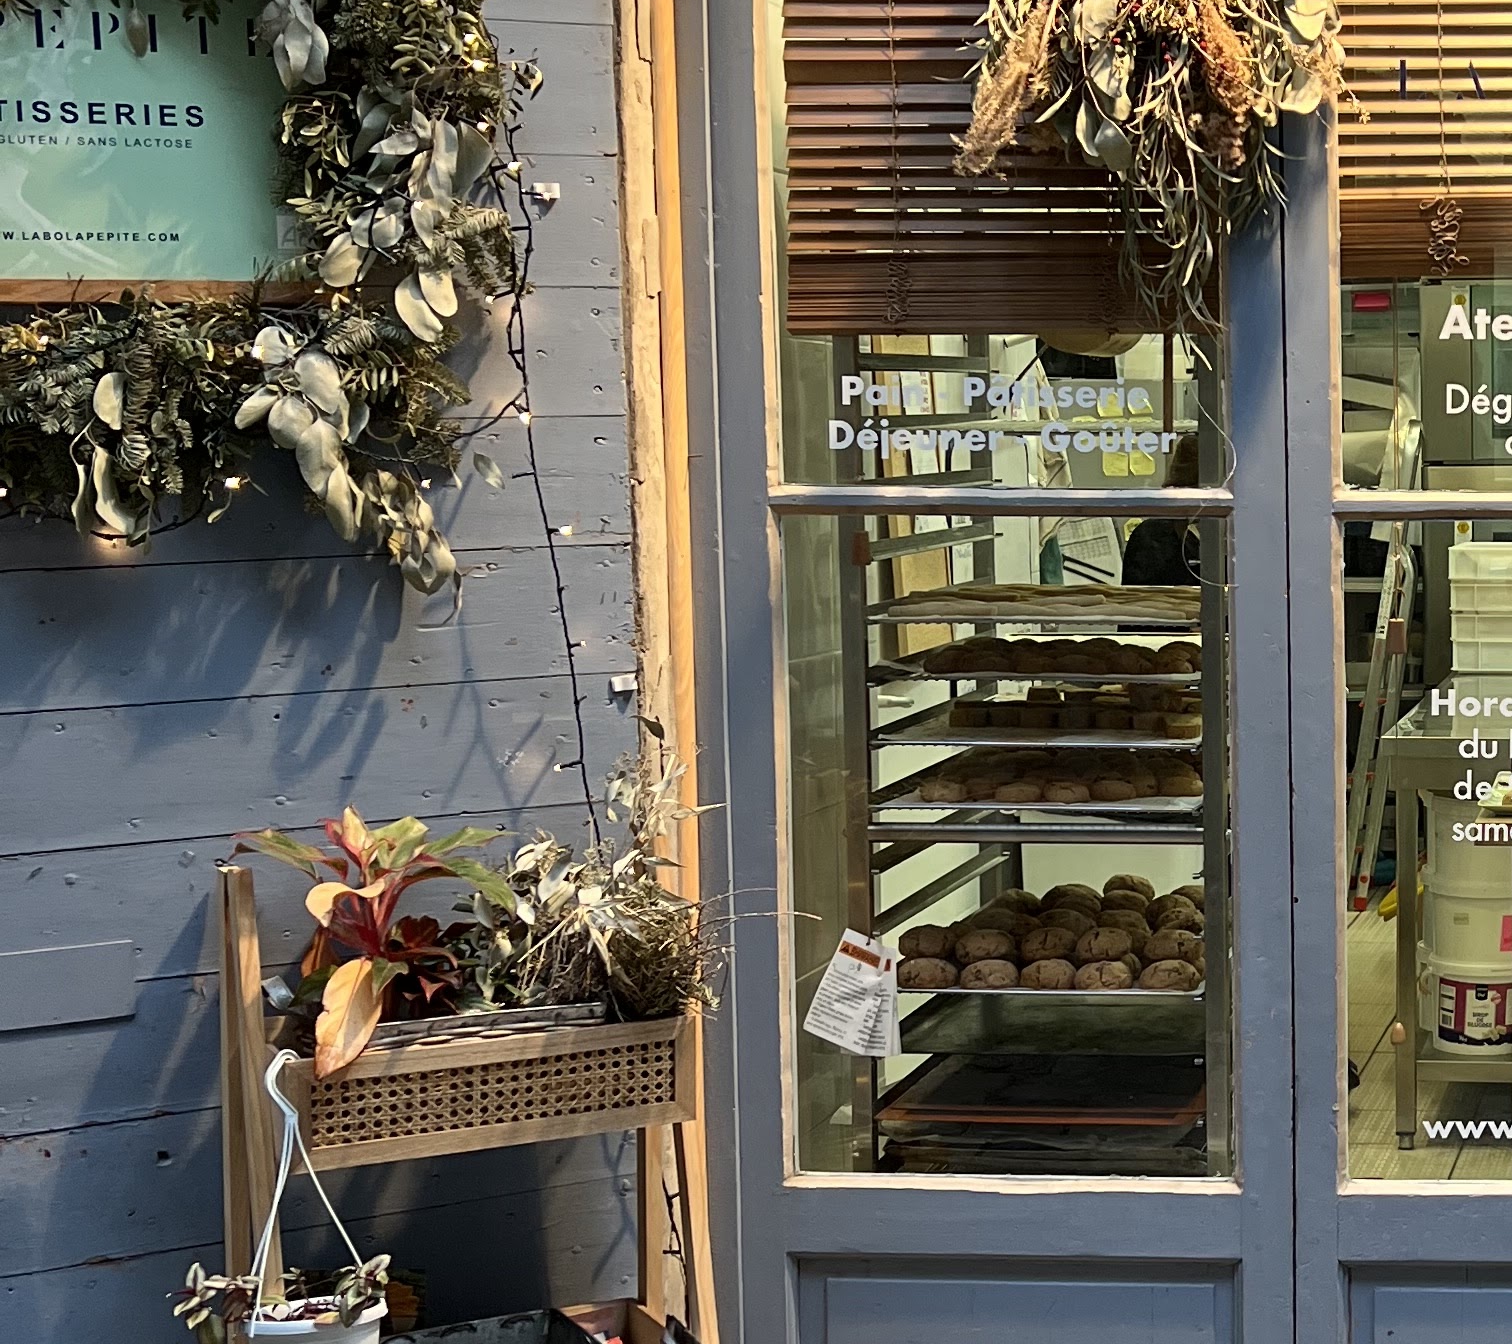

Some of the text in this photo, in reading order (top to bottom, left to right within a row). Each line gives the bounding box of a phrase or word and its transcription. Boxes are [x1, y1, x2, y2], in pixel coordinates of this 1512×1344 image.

[1400, 59, 1487, 100] LA
[77, 136, 117, 147] SANS
[125, 138, 193, 149] LACTOSE
[841, 375, 925, 407] Pain
[964, 376, 1150, 410] Pâtisserie
[828, 417, 1008, 460] Déjeuner
[1040, 422, 1178, 455] Goûter
[1458, 730, 1499, 760] du
[1453, 773, 1492, 802] de
